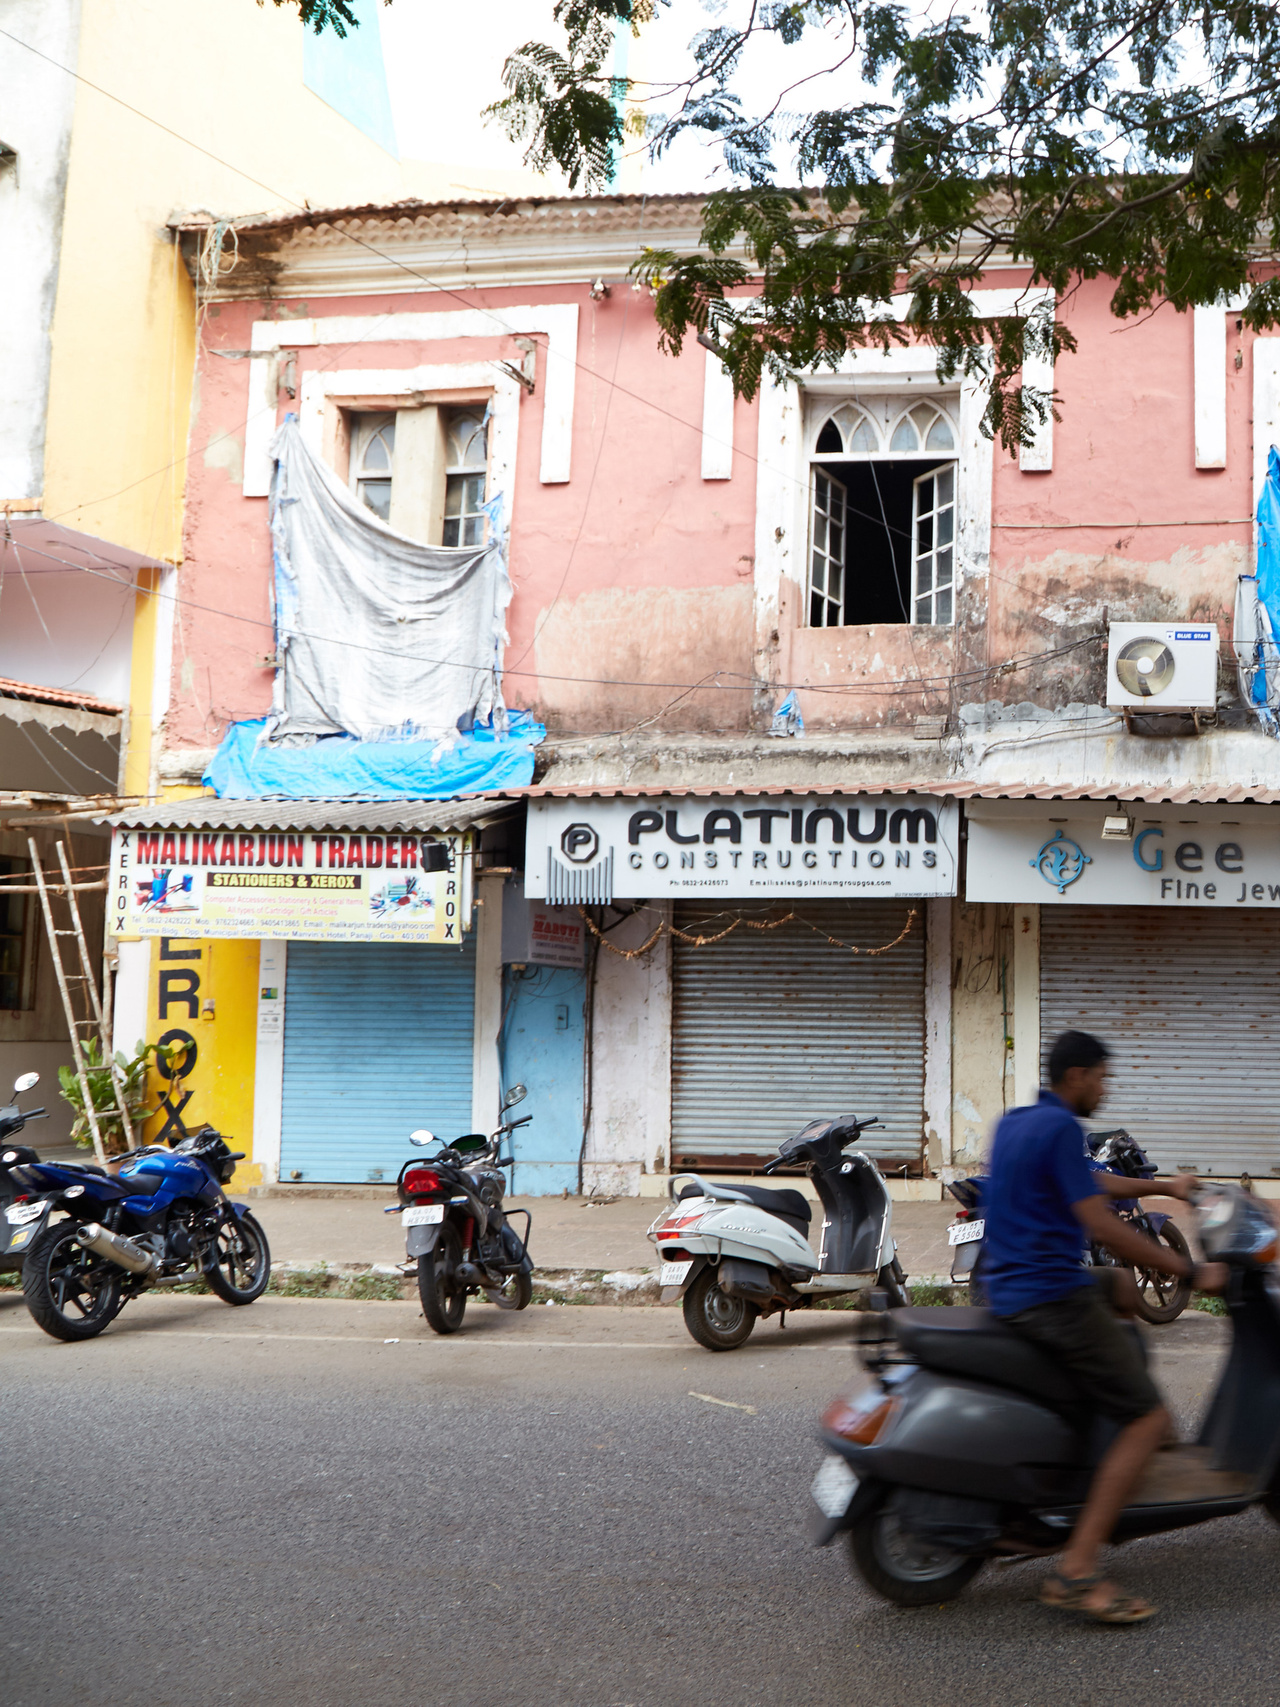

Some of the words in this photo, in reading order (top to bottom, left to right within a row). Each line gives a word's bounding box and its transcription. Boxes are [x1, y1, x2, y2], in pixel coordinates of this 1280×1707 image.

[628, 808, 937, 845] PLATINUM
[137, 832, 304, 868] MALIKARJUN
[1132, 828, 1244, 874] Gee
[628, 850, 938, 869] CONSTRUCTIONS
[213, 873, 294, 888] STATIONERS
[297, 876, 308, 888] &
[311, 875, 355, 889] XEROX
[204, 895, 236, 905] Computer
[237, 896, 277, 904] Accessories
[278, 896, 311, 906] Stationery
[319, 897, 345, 905] General
[237, 907, 255, 916] types
[265, 907, 294, 917] Cartridge
[313, 908, 338, 916] Articles
[203, 928, 239, 938] Municipal
[272, 930, 290, 938] Near
[350, 931, 373, 941] Panaji
[379, 932, 395, 940] Goa
